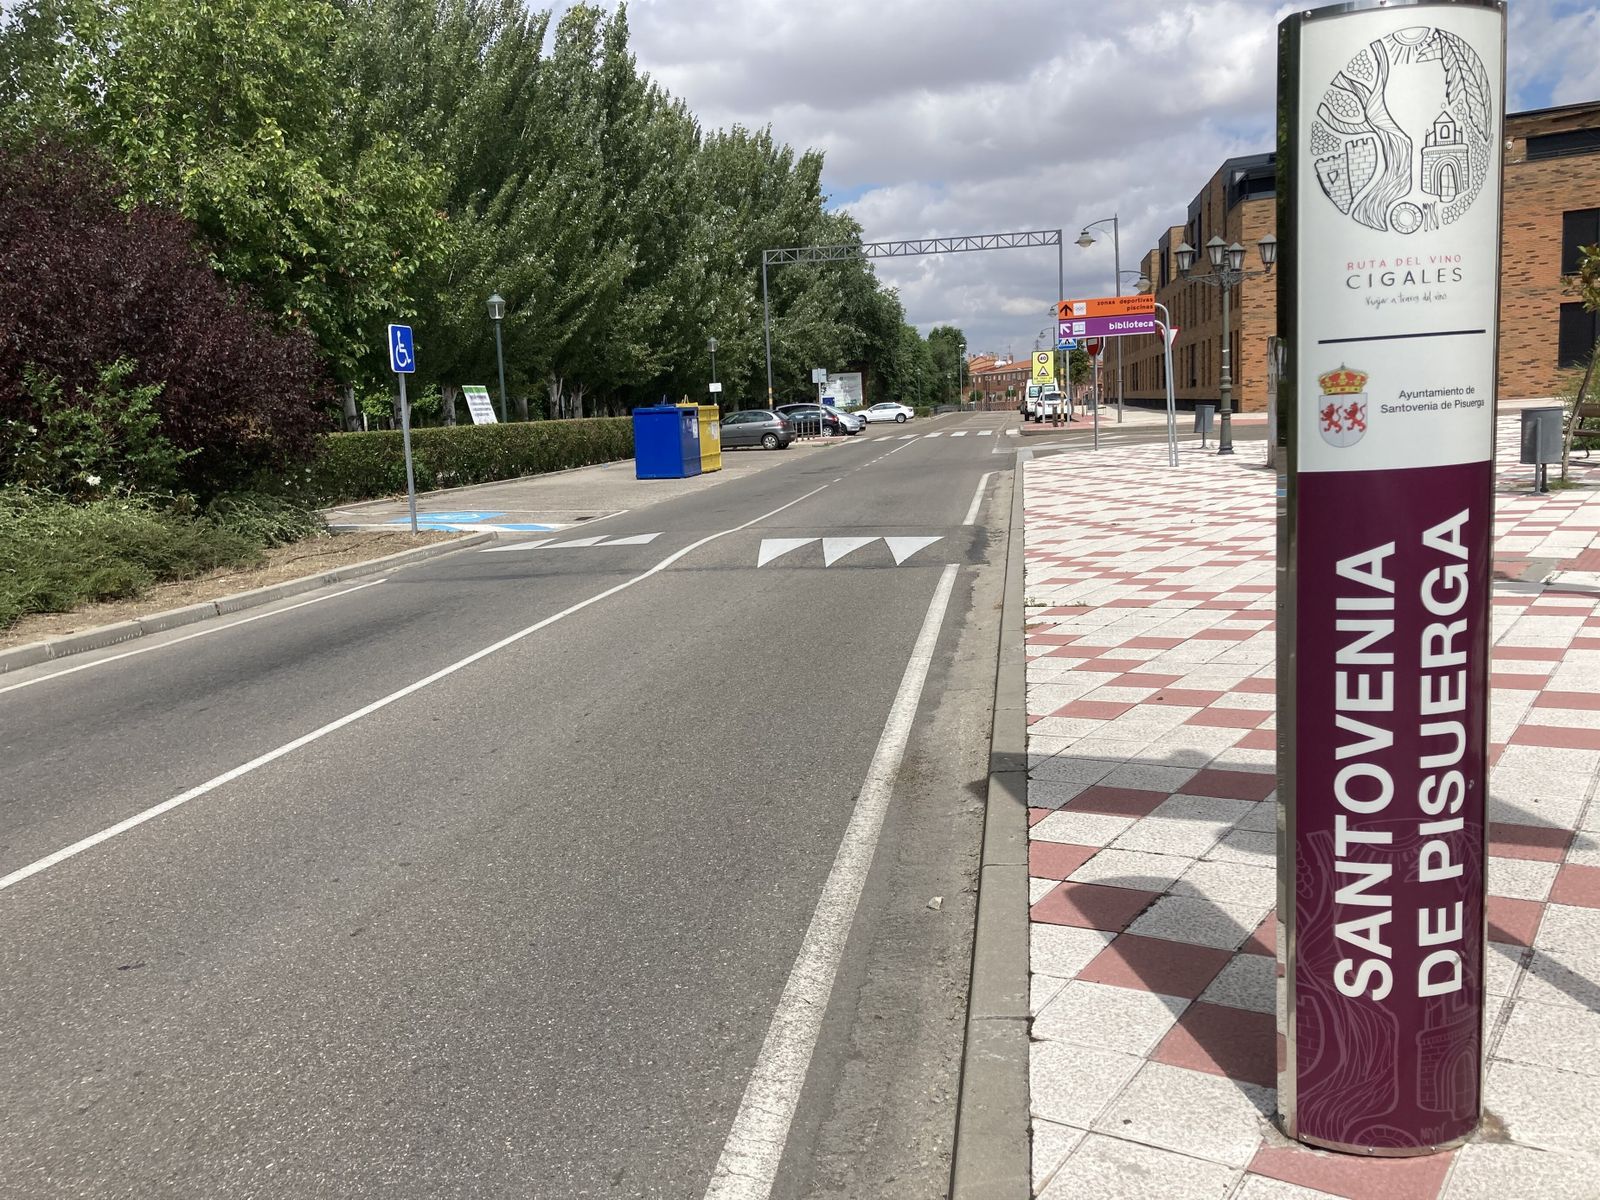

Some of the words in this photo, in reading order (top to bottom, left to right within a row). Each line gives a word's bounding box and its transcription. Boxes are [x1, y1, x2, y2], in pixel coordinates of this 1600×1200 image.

[1347, 260, 1387, 271] RUTA
[1396, 257, 1421, 267] DEL
[1429, 254, 1462, 264] VINO
[1346, 267, 1463, 290] CIGALES
[1119, 297, 1153, 305] deportivas
[1126, 304, 1154, 312] piscinas
[1109, 320, 1154, 330] biblioteca
[1398, 387, 1464, 401] Ayuntamiento
[1465, 385, 1475, 395] de
[1380, 401, 1439, 414] Santovenia
[1440, 400, 1452, 410] de
[1454, 399, 1485, 409] Pisuerga
[1418, 508, 1470, 883] PISUERGA
[1333, 541, 1397, 1002] SANTOVENIA
[1418, 901, 1464, 998] DE
